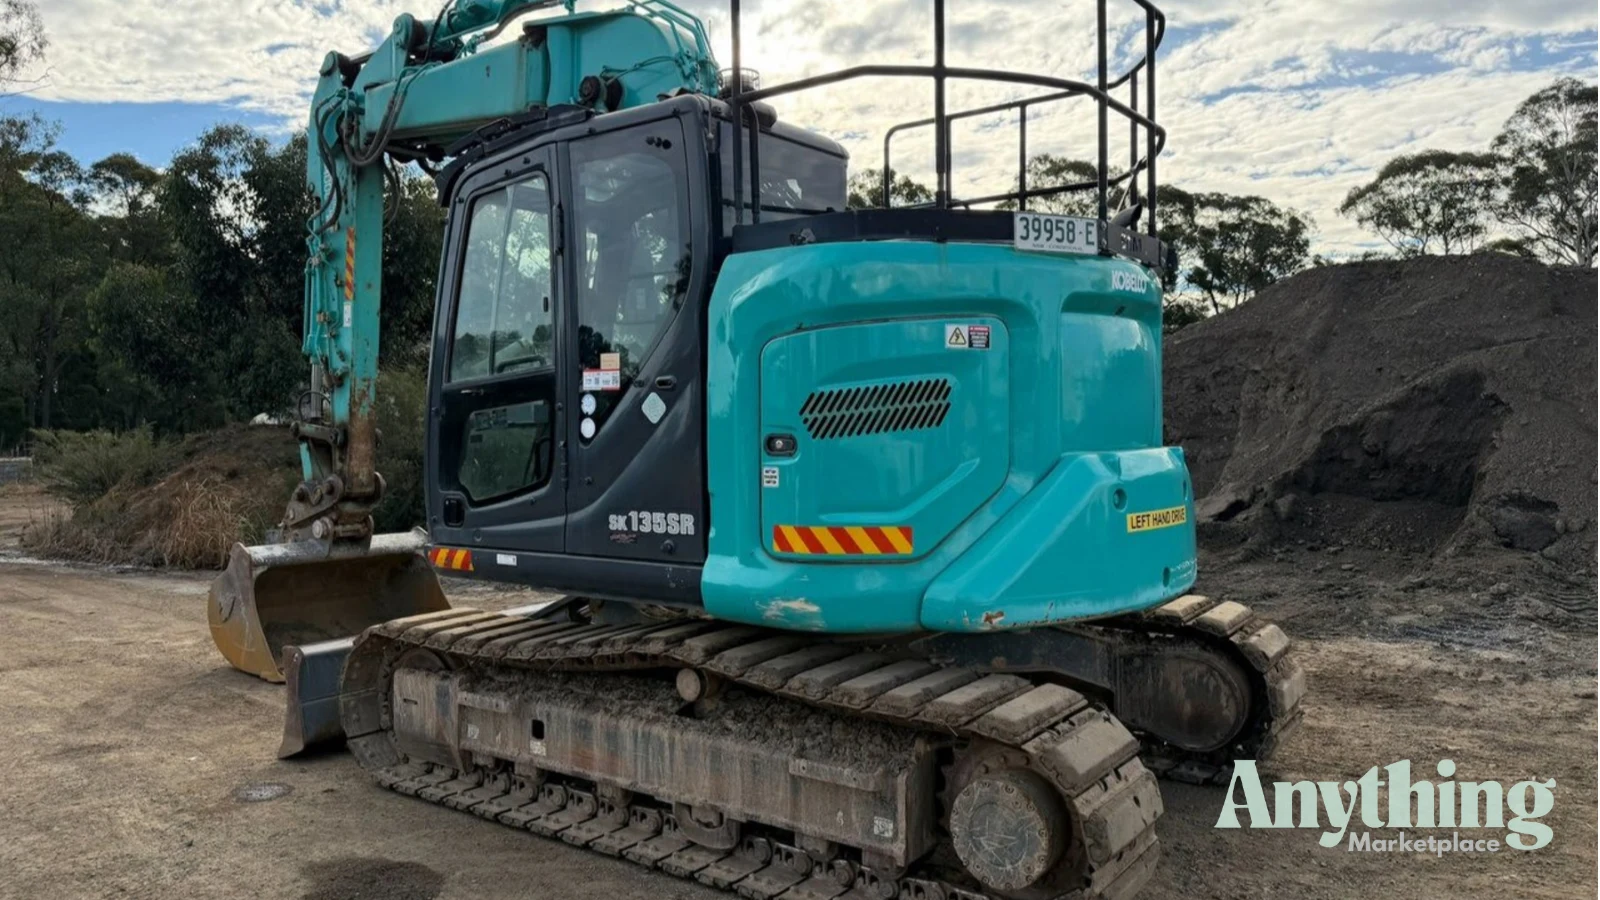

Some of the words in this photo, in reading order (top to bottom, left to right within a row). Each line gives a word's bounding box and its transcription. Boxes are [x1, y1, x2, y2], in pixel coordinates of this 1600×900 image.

[1111, 269, 1147, 294] KOBELCO
[608, 510, 695, 535] SK135SR
[1130, 514, 1151, 530] LEFT
[1152, 511, 1170, 526] HAND
[1171, 507, 1185, 524] DRIVE
